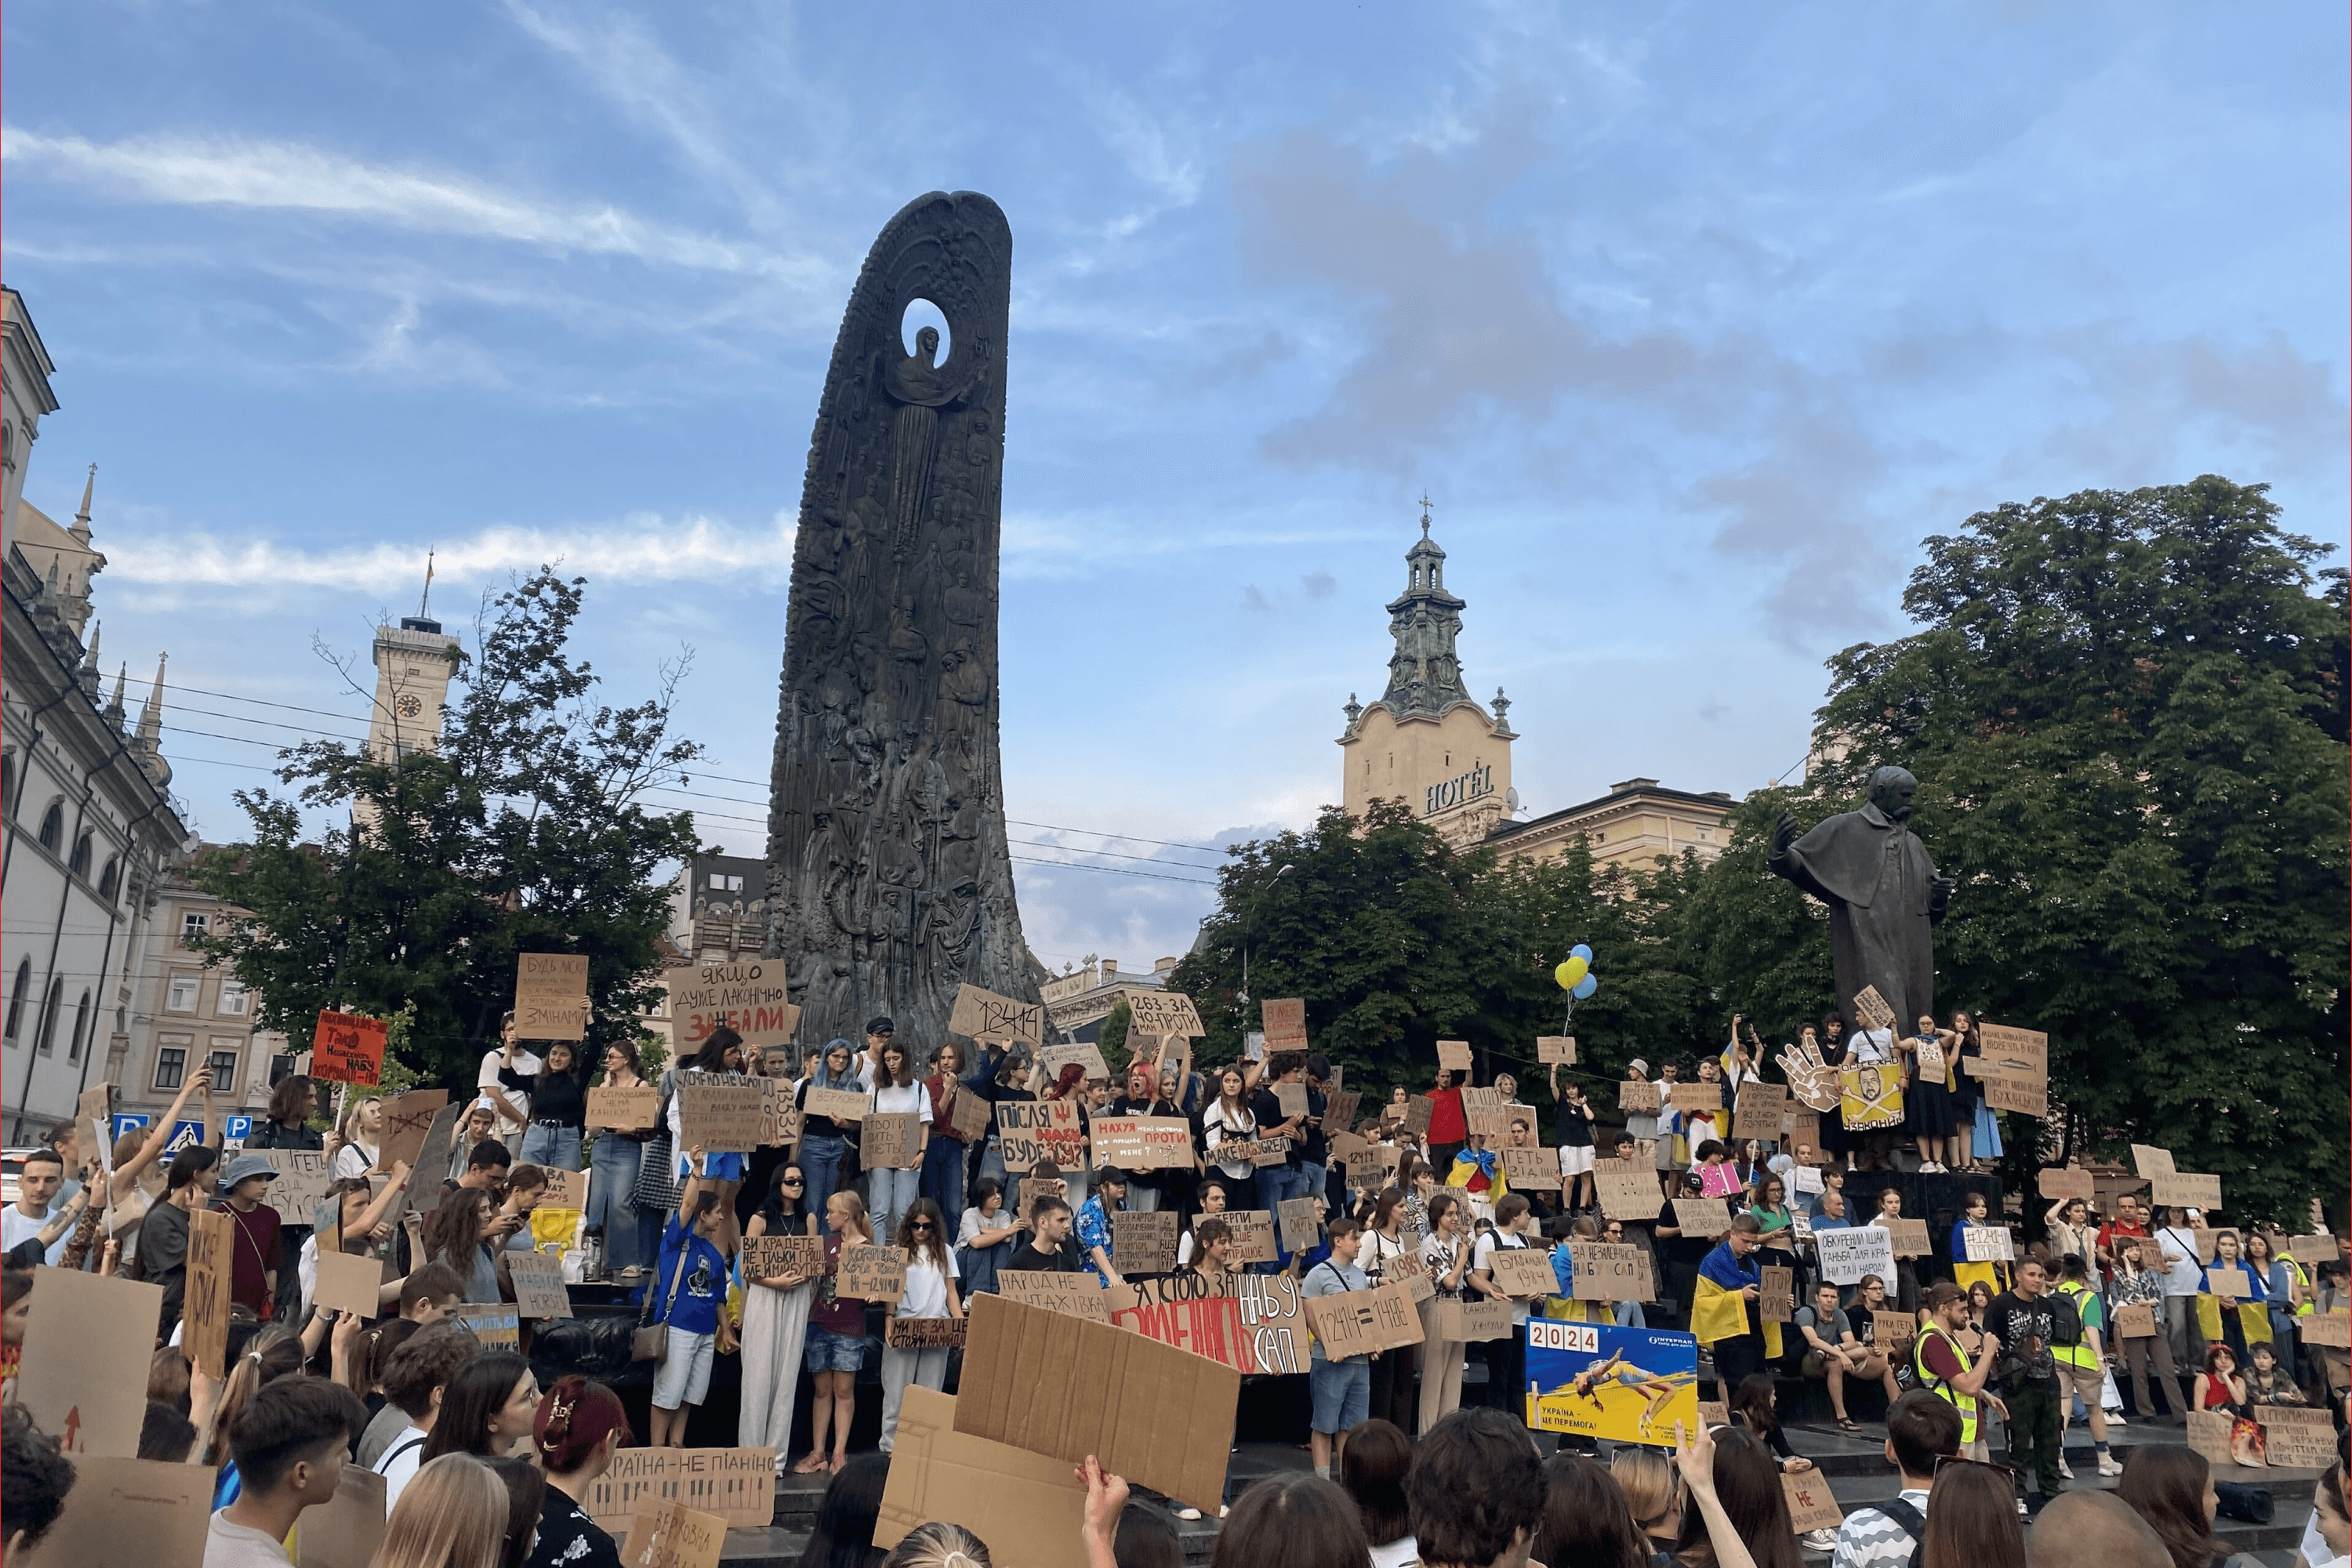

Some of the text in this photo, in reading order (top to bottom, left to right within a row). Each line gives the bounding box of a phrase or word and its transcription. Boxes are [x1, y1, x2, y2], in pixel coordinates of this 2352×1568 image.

[1424, 764, 1494, 815] HOTEL
[528, 956, 556, 975] БУДЬ
[702, 965, 762, 986] ЯКЩО
[675, 986, 782, 1011] ДУЖЕ ЛАКОНІЧНО
[590, 1108, 630, 1117] КАНІКУЛ
[776, 1086, 797, 1140] 13531
[997, 1102, 1052, 1128] ПІСЛЯ
[233, 1119, 247, 1136] P
[1036, 1127, 1081, 1142] НАБУ
[1098, 1123, 1135, 1134] НАХУЯ
[1145, 1133, 1187, 1144] ПРОТИ
[1003, 1138, 1044, 1164] БУДЕ
[1206, 1136, 1291, 1167] MAKE GREAT
[1506, 1150, 1543, 1164] ГЕТЬ
[293, 1153, 327, 1171] ГЕТЬ
[1510, 1166, 1537, 1178] ВІД
[275, 1180, 303, 1192] ВІД
[1116, 1214, 1131, 1222] ЦЕЙ
[743, 1238, 815, 1250] ВИ КРАДЕТЕ
[1823, 1232, 1864, 1249] ОБКУРЕНИЙ
[743, 1251, 755, 1264] НЕ
[760, 1251, 796, 1264] ТІЛЬКИ
[1573, 1245, 1585, 1260] ЗА
[1824, 1250, 1851, 1263] ГАНЬБА
[1855, 1250, 1869, 1261] ДЛЯ
[743, 1263, 760, 1276] АЛЕ
[1392, 1253, 1425, 1282] 1984
[1614, 1262, 1635, 1276] САП
[1859, 1263, 1886, 1275] НАРОДУ
[850, 1274, 859, 1292] Ні
[1001, 1275, 1078, 1290] НАРОД НЕ
[1516, 1270, 1548, 1288] 1984
[1762, 1271, 1791, 1291] STOP
[1133, 1283, 1145, 1307] Я
[1215, 1273, 1235, 1298] ЗА
[1238, 1273, 1298, 1325] НАБУ
[893, 1319, 968, 1334] МИ НЕ ЗА ЦЕ
[1877, 1318, 1914, 1330] РУКИ ГЕТЬ
[892, 1334, 927, 1348] СТОЯЛИ
[1533, 1327, 1595, 1349] 2024
[1876, 1336, 1891, 1348] НАБ
[1255, 1327, 1298, 1374] САП
[1542, 1406, 1574, 1417] УКРАЇНА
[1542, 1417, 1597, 1430] ЦЕ ПЕРЕМОГА!
[680, 1452, 775, 1472] НЕ ПІАНІНО
[1795, 1490, 1815, 1508] НЕ
[654, 1511, 710, 1552] ВЕРХОВНА
